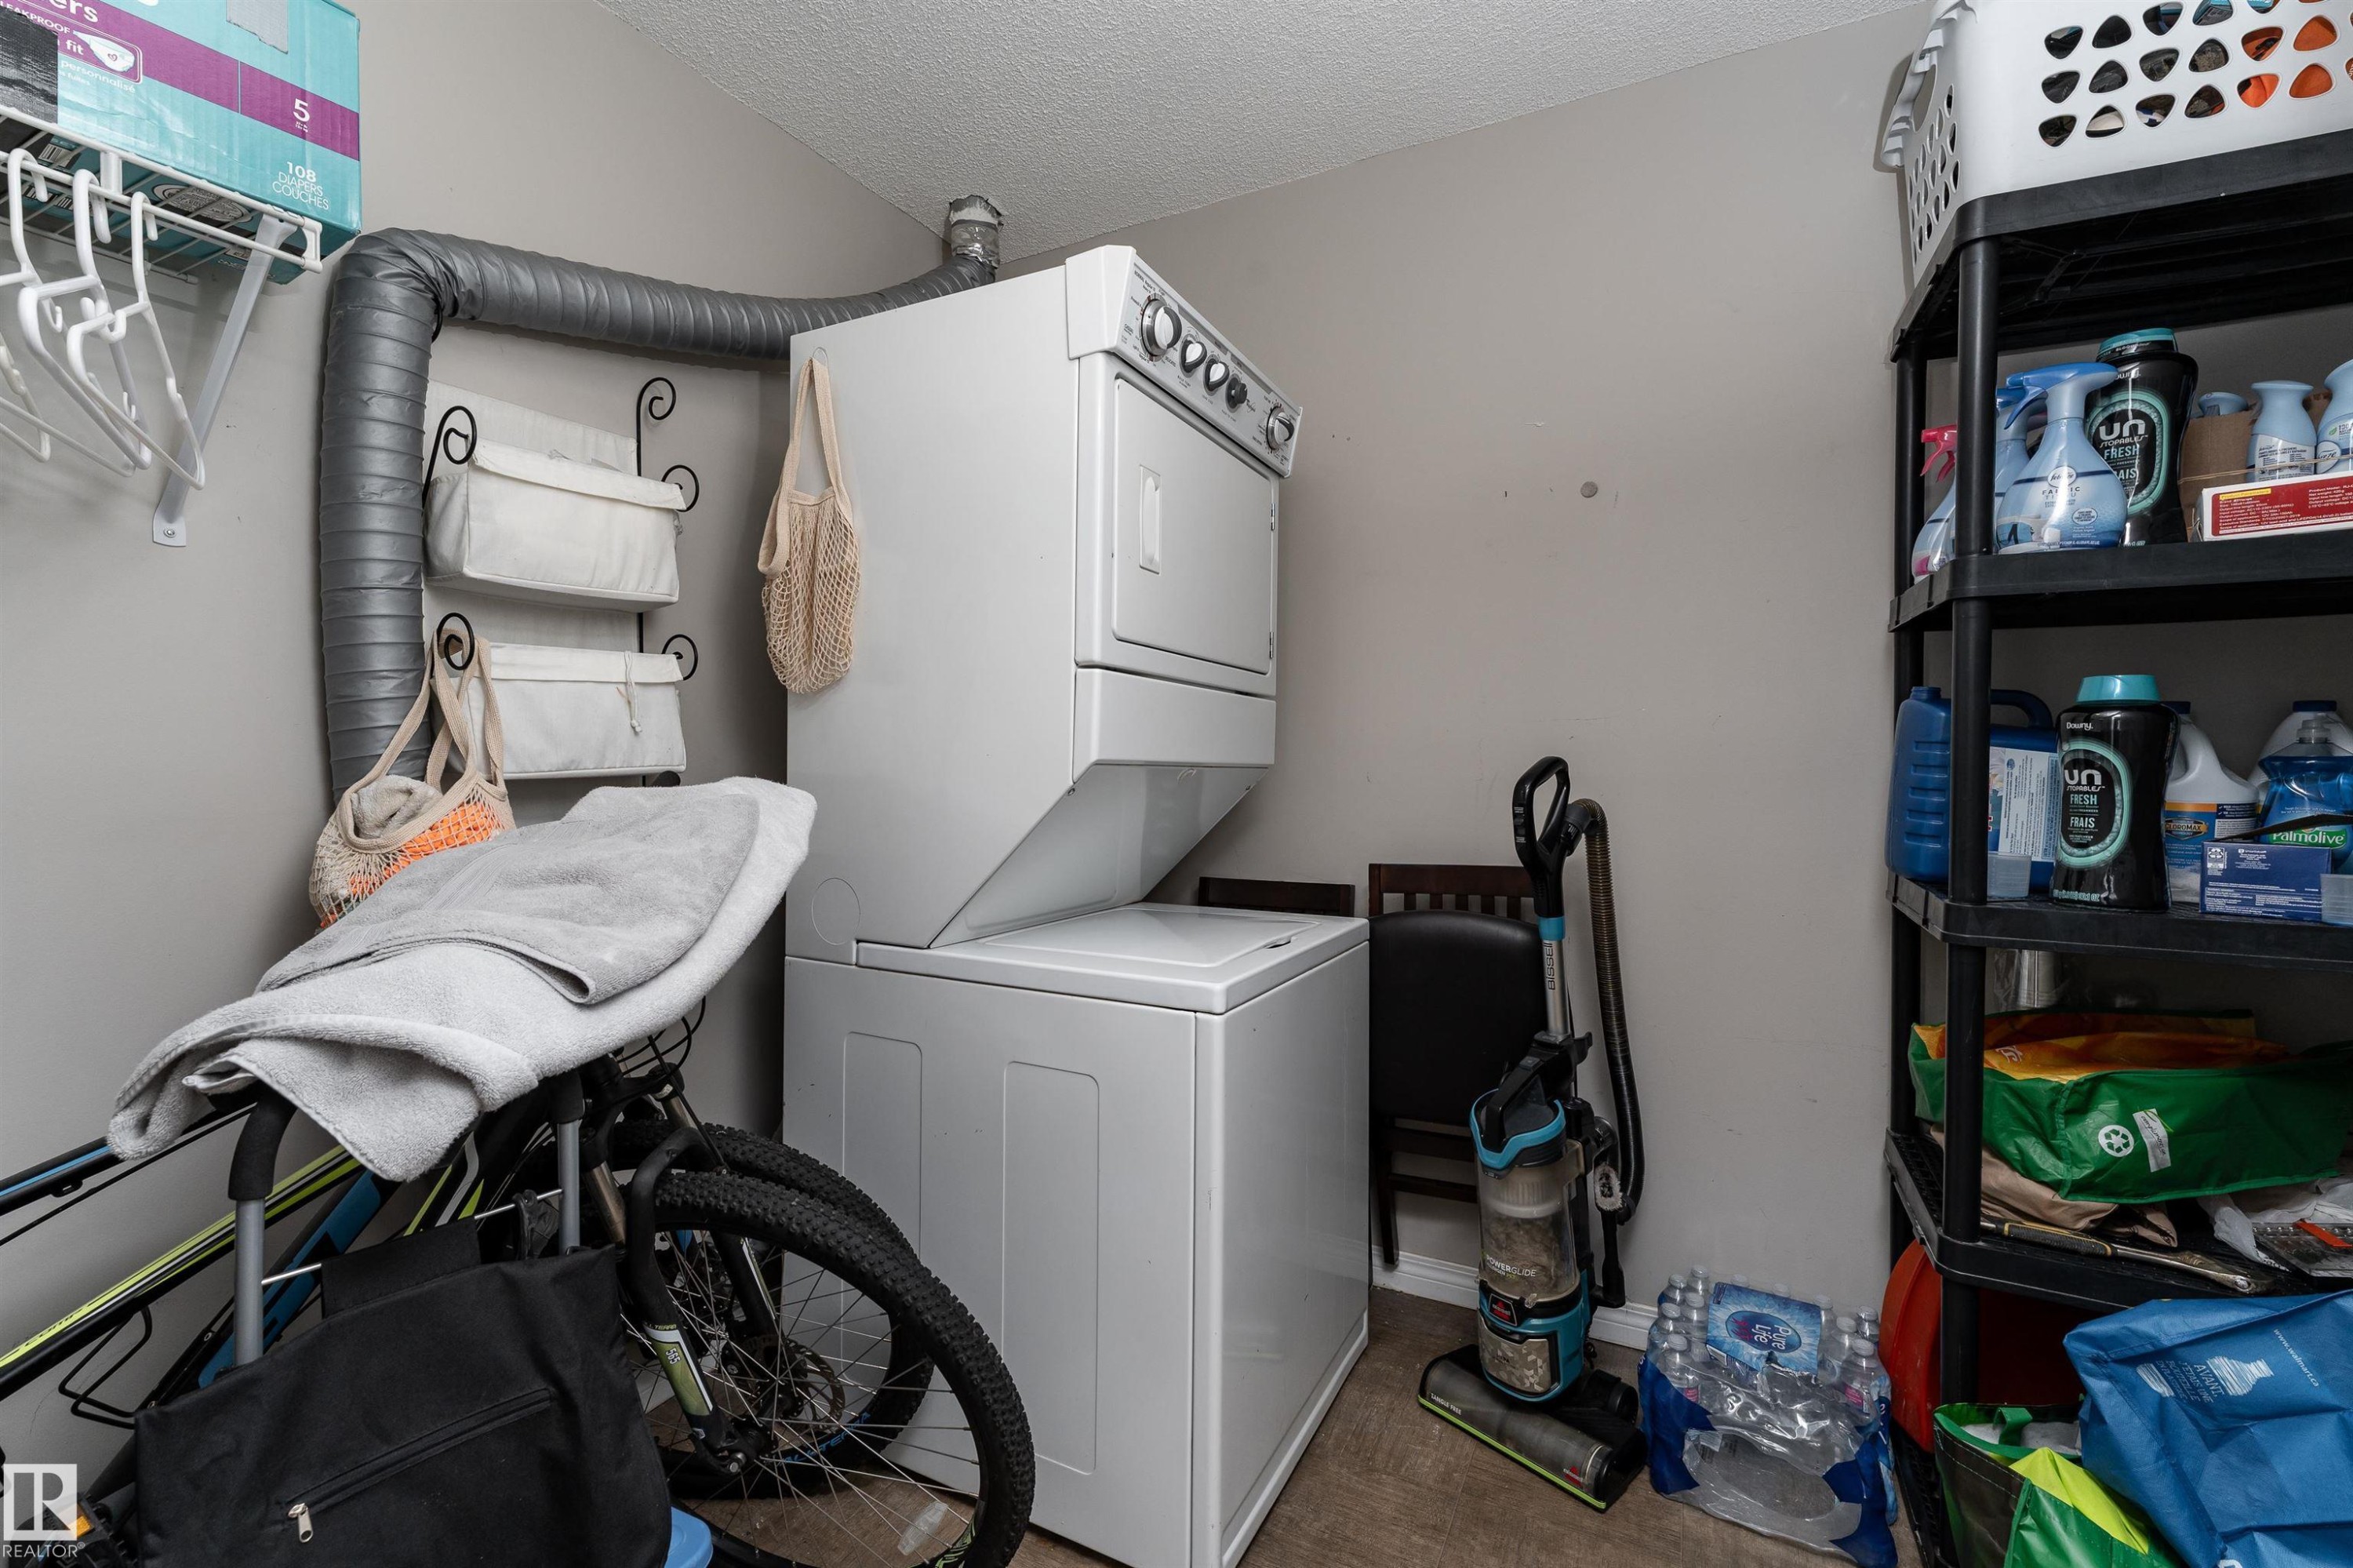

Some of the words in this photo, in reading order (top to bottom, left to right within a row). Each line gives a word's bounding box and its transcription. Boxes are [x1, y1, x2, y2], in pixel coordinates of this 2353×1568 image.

[66, 39, 84, 55] fit
[293, 98, 310, 122] 5
[287, 162, 317, 183] 108
[278, 171, 323, 196] DIAPERS
[272, 180, 329, 210] COUCHES
[2104, 446, 2139, 460] FRESH
[2042, 486, 2080, 495] FAIC
[2071, 794, 2097, 805] FRESH
[2070, 817, 2095, 828] FRAIS
[2273, 831, 2344, 845] Palmolive
[1486, 1254, 1537, 1276] POWERGLIDE
[1751, 1323, 1773, 1344] Life
[1772, 1325, 1791, 1350] Pure
[665, 1348, 681, 1365] 565
[2274, 1329, 2319, 1387] www.walmart.ca
[1431, 1393, 1449, 1408] TANGLE
[1450, 1404, 1462, 1415] FREE
